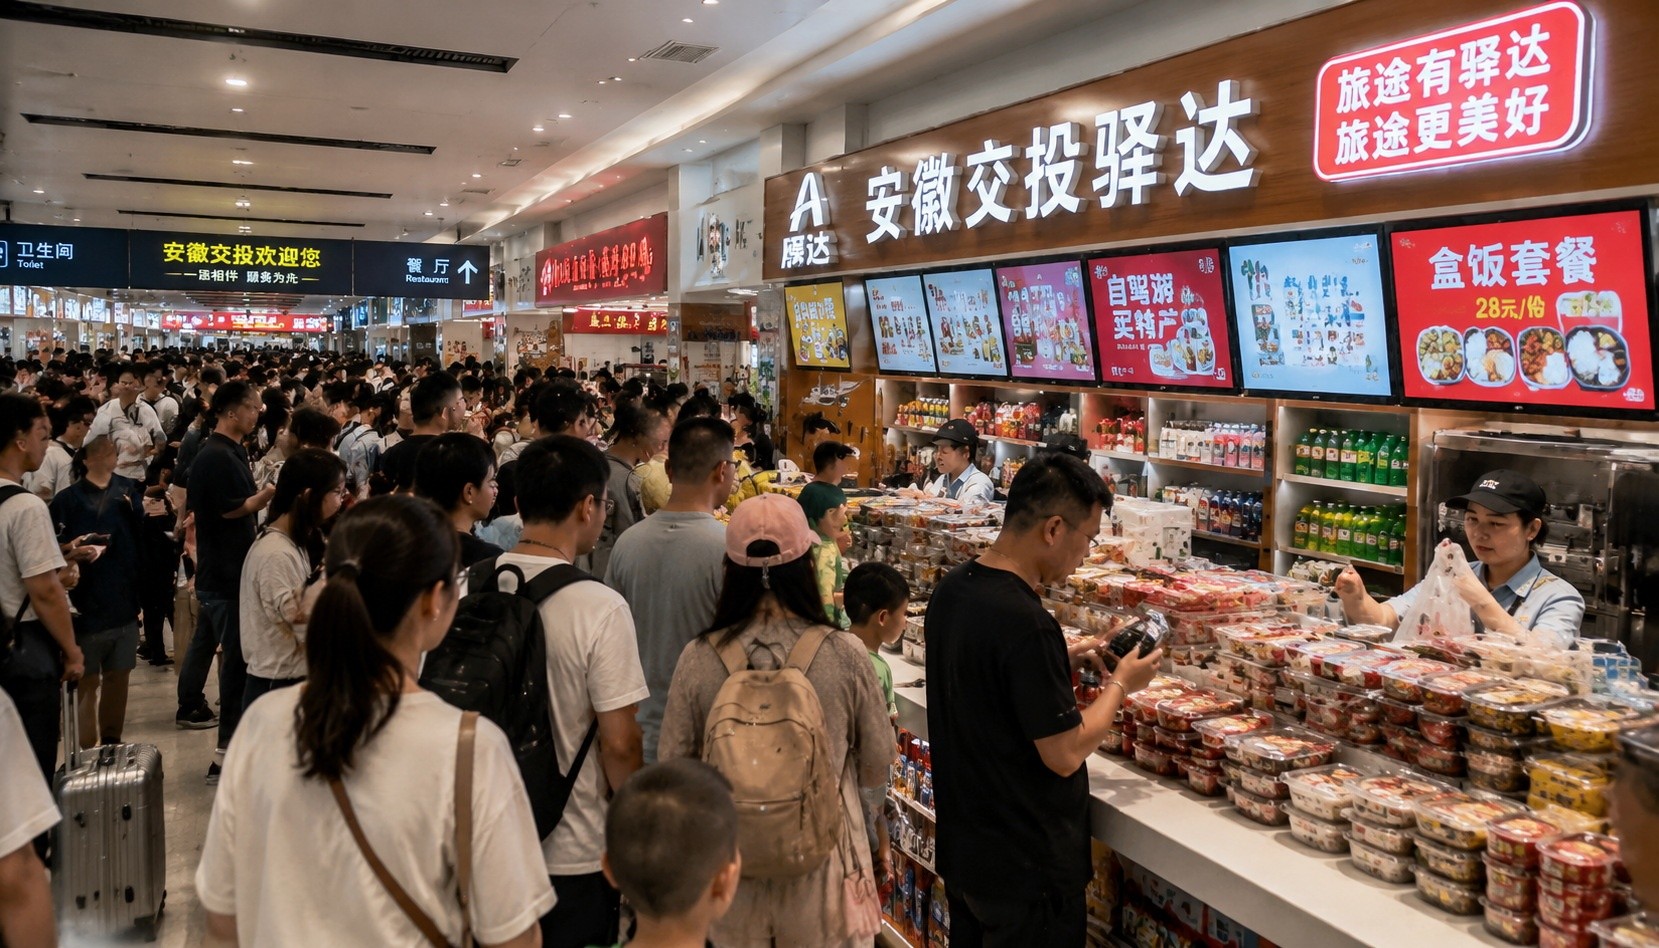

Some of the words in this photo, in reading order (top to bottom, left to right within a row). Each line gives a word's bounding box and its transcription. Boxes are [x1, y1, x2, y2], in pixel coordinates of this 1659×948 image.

[1336, 23, 1551, 113] 旅途有驿达
[865, 79, 1255, 244] 安徽交投驿达
[1334, 84, 1550, 165] 旅途更美好
[163, 241, 322, 268] 安徽交投欢迎您
[1428, 236, 1597, 290] 盒饭套餐
